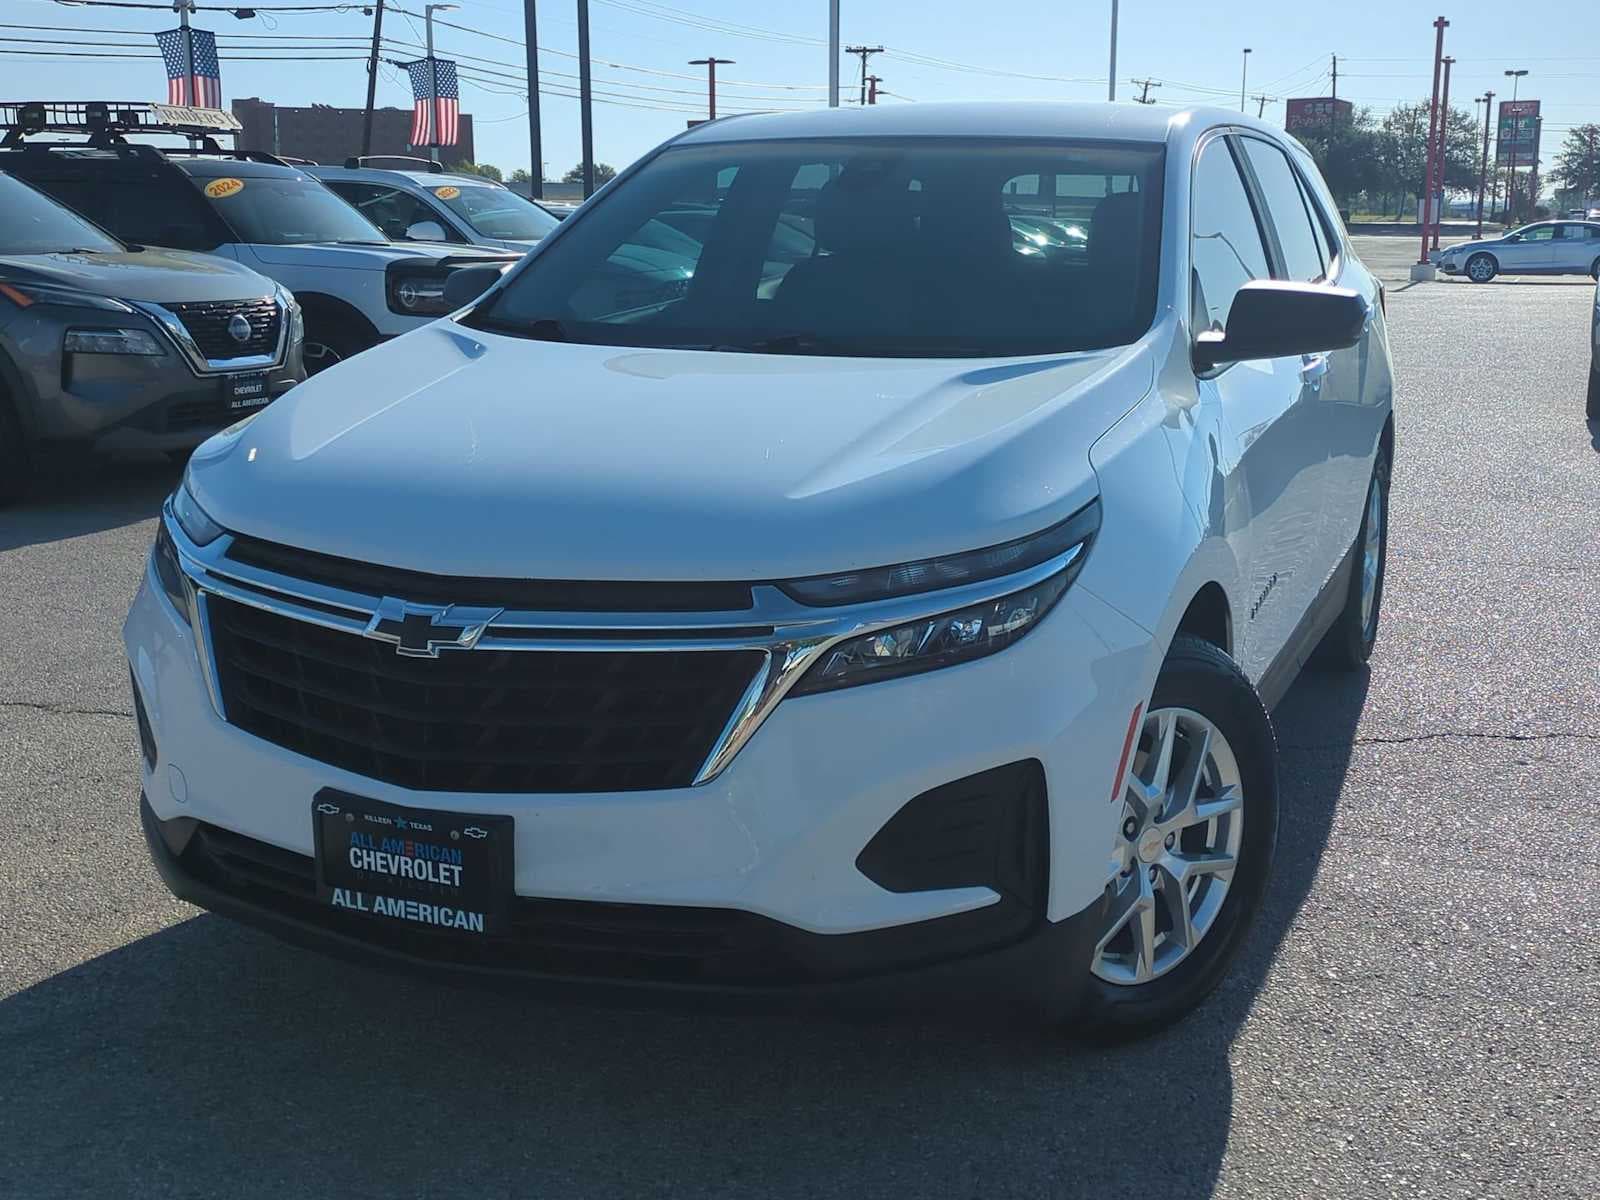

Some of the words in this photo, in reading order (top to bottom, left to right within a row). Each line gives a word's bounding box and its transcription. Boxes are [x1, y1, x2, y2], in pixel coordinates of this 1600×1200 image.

[208, 180, 241, 196] 2024
[364, 814, 392, 825] KILLEEN
[409, 821, 433, 832] TEXAS
[351, 831, 377, 849] ALL
[382, 837, 462, 863] AMERICAN
[349, 847, 463, 887] CHEVROLET
[331, 887, 369, 912] ALL
[373, 895, 484, 933] AMERICAN
